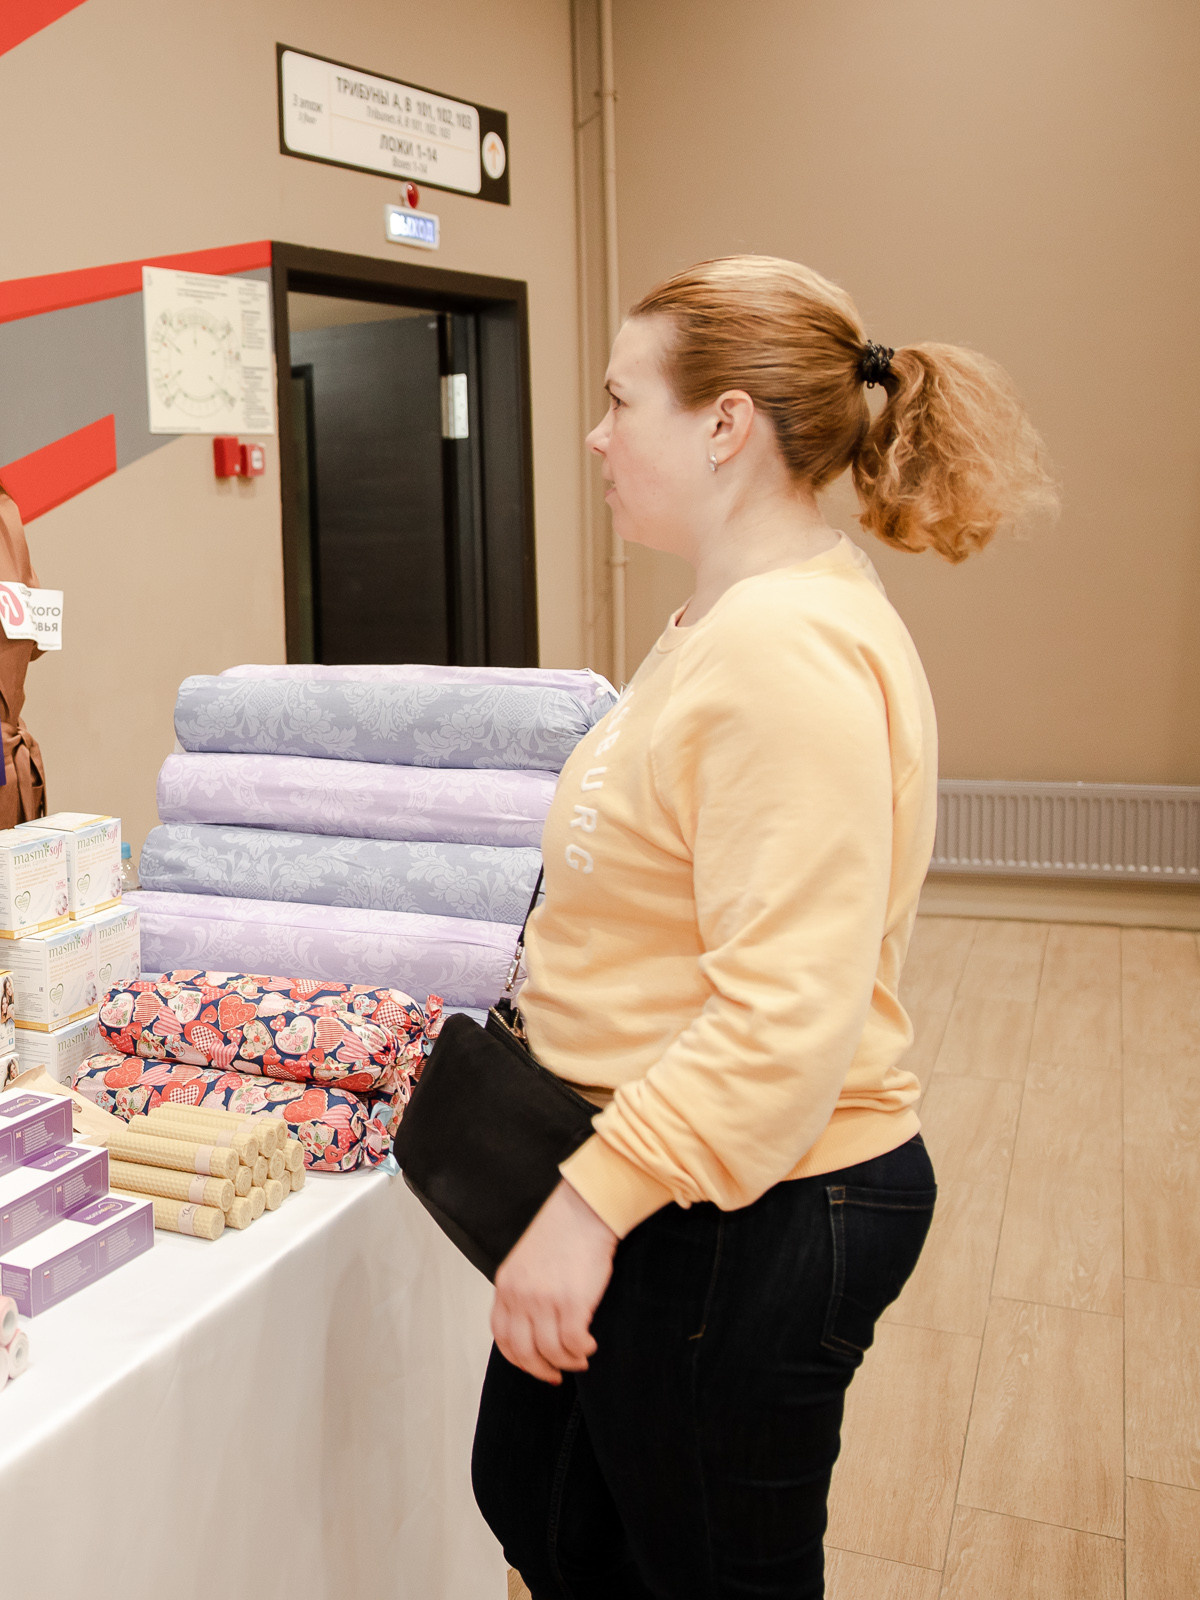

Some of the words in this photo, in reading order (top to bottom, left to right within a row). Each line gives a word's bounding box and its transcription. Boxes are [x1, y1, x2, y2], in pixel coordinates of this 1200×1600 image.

[336, 76, 389, 105] ТРИБУНЫ
[456, 112, 472, 130] 103
[380, 134, 413, 156] ЛОЖИ
[77, 827, 107, 849] masmi
[14, 842, 49, 865] masmi
[49, 839, 63, 859] soft
[99, 916, 127, 939] masmi
[49, 934, 81, 958] masmi
[80, 930, 92, 950] soft
[58, 1025, 88, 1052] masmi
